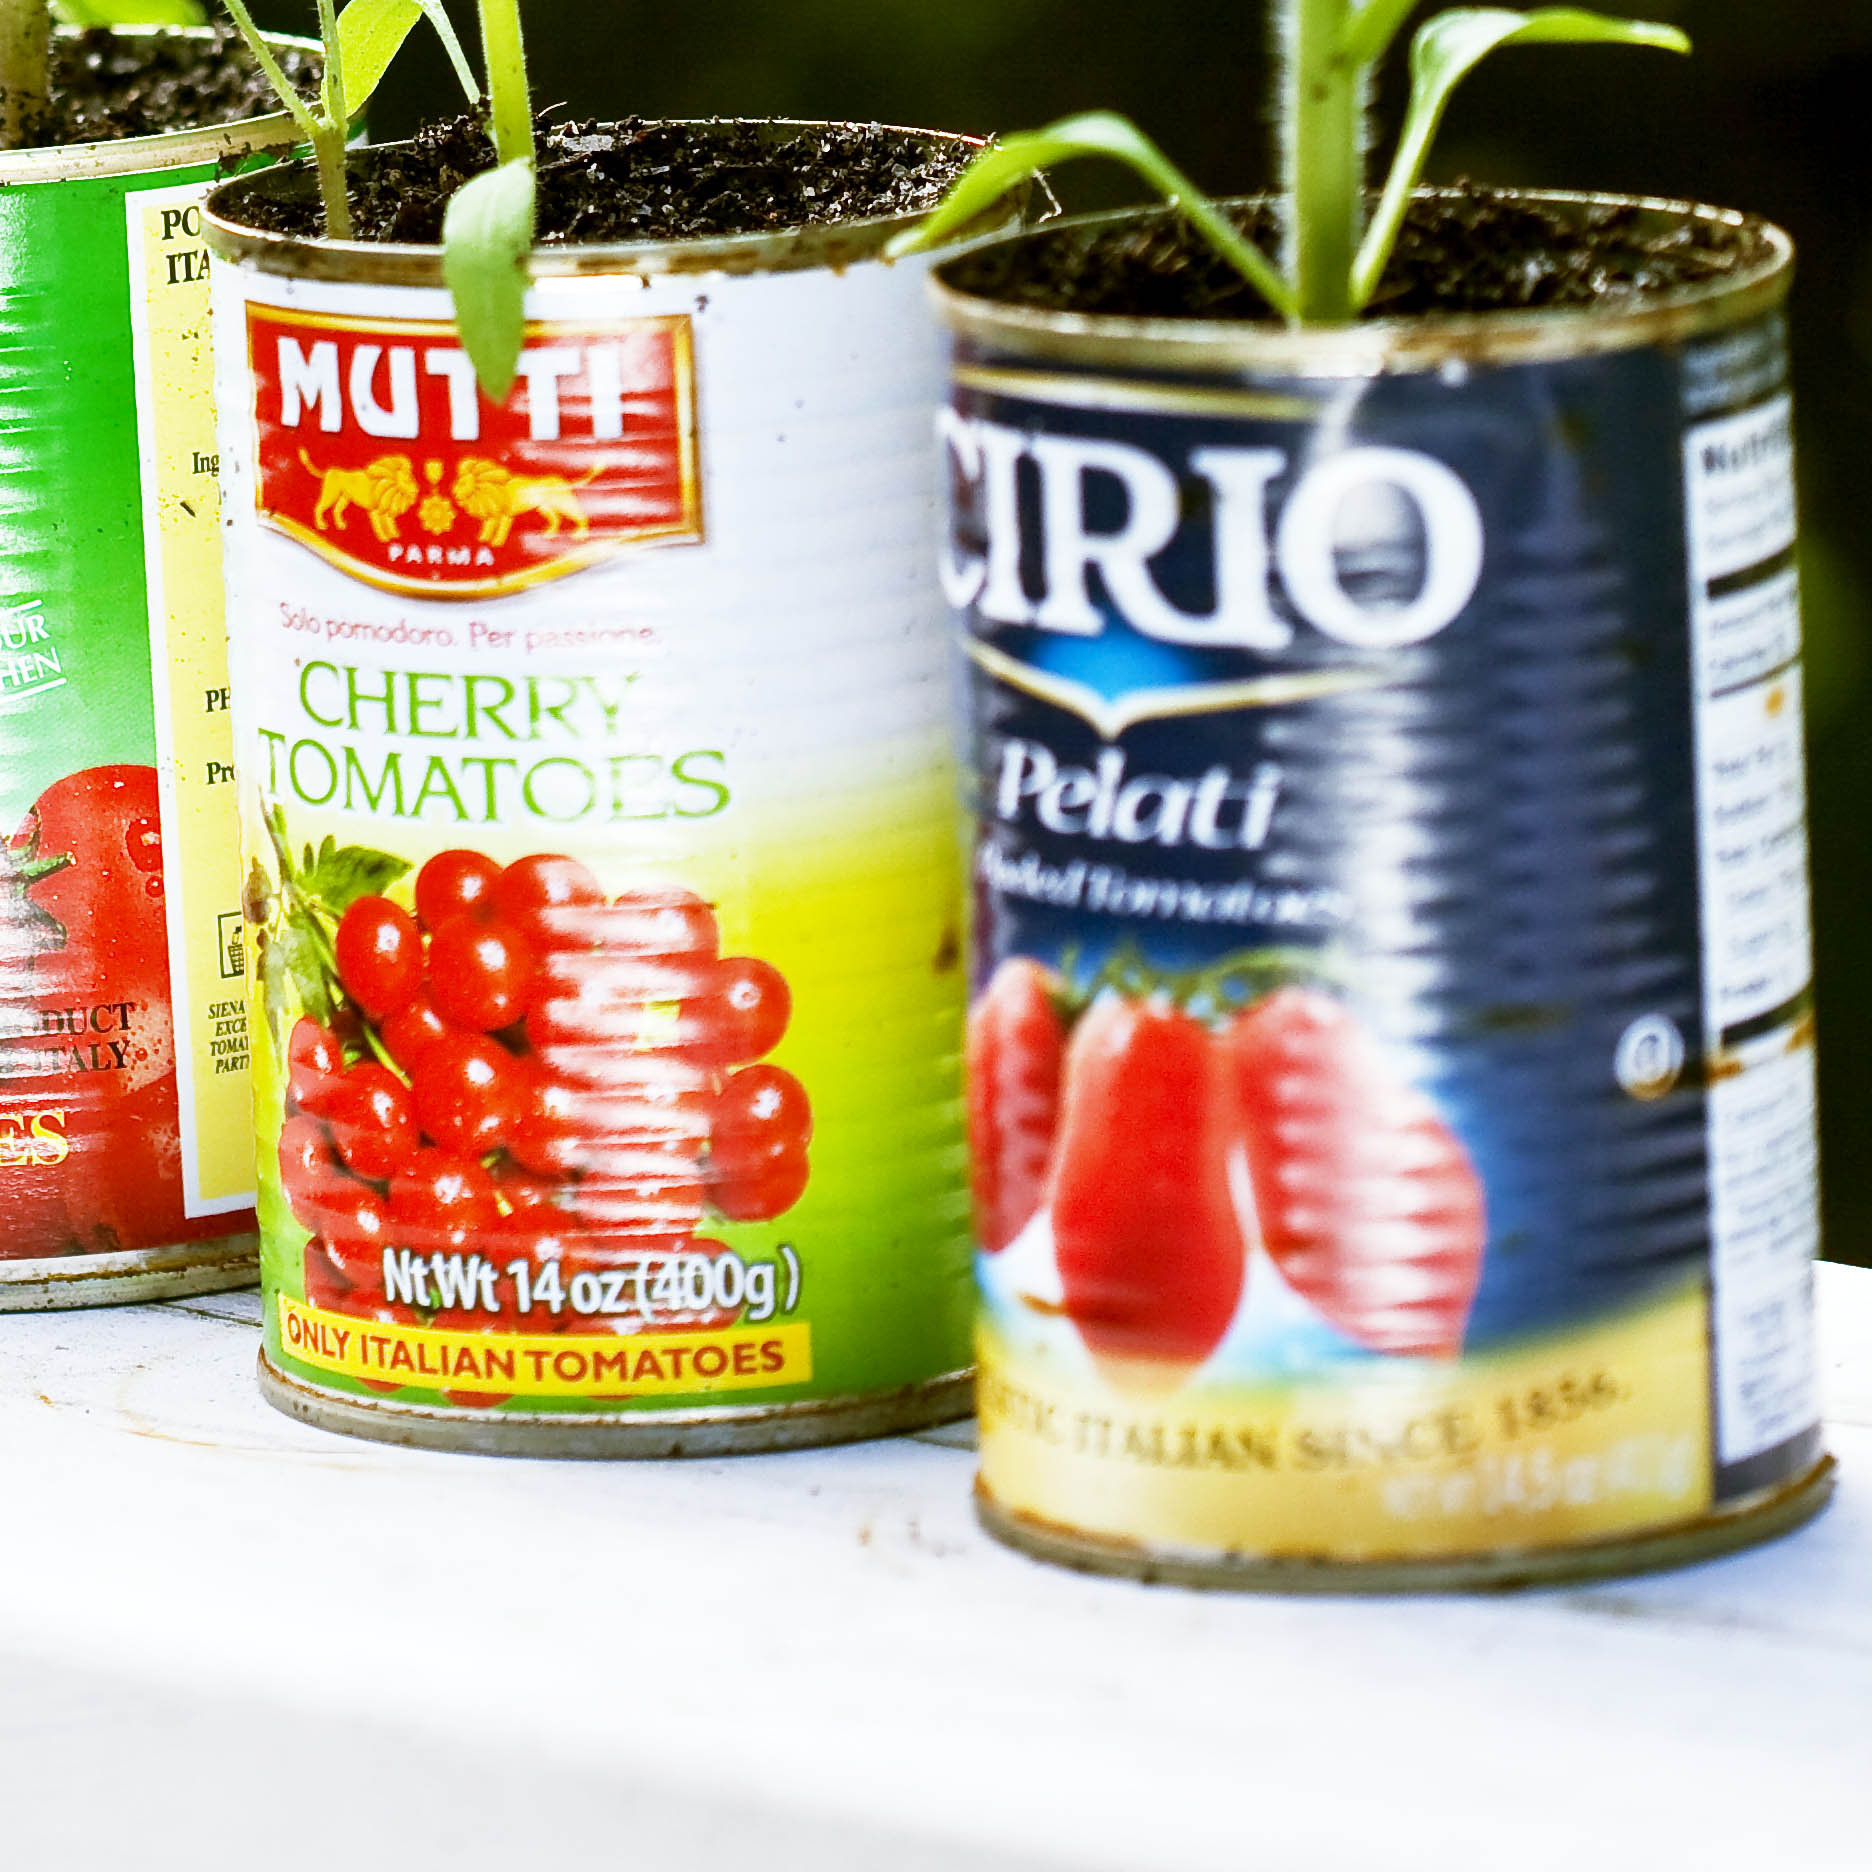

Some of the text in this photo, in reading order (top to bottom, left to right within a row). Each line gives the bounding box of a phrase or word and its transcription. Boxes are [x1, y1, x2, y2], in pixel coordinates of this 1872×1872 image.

[277, 335, 623, 441] MUTTI
[388, 542, 495, 567] PARMA
[936, 405, 1484, 650] CIRIO
[279, 601, 321, 635] Solo
[325, 618, 458, 648] pomodoro.
[469, 620, 514, 649] Per
[298, 660, 642, 741] CHERRY
[257, 727, 731, 823] TOMATOES
[998, 739, 1285, 851] Pelati
[8, 1001, 136, 1038] DUCT
[35, 1039, 131, 1075] ITALY
[507, 1260, 566, 1314] 14
[570, 1269, 628, 1316] oz
[286, 1312, 787, 1385] ONLY ITALIAN TOMATOES
[1073, 1411, 1281, 1472] ITALIAN
